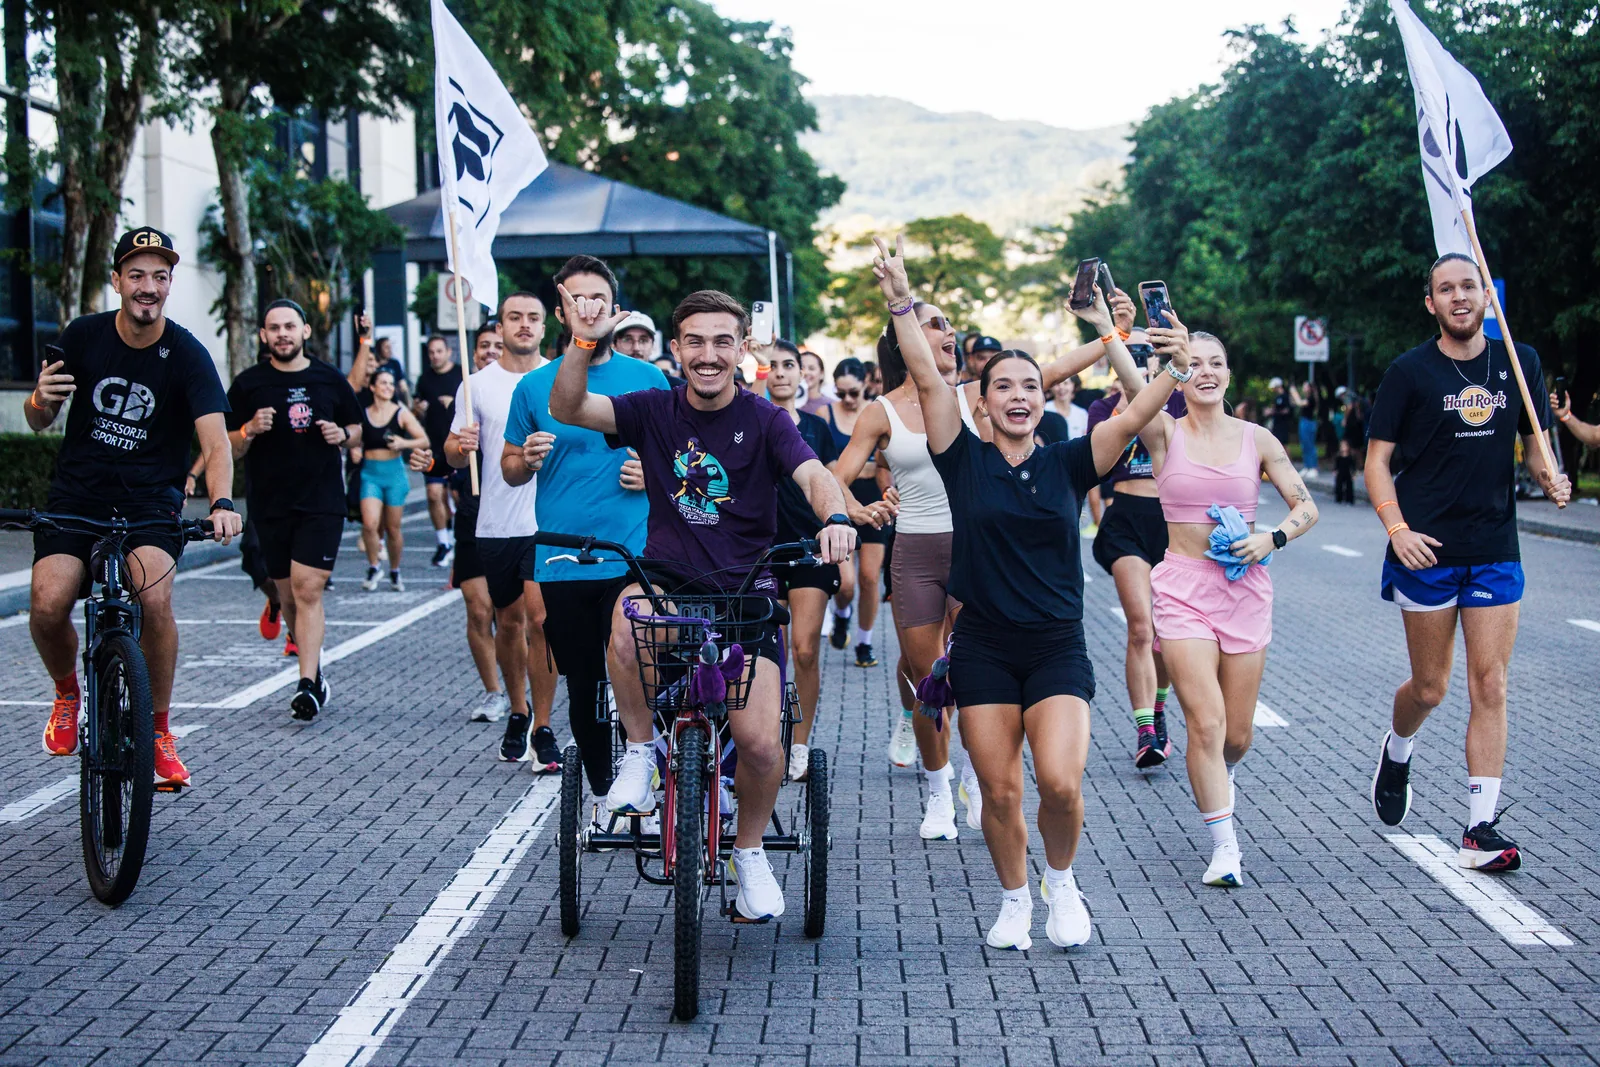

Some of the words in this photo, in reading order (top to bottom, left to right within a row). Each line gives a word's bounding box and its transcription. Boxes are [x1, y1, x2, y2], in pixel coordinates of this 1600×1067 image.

[1443, 394, 1474, 411] Hard
[1475, 391, 1507, 409] Rock
[91, 429, 139, 451] SPORTIV
